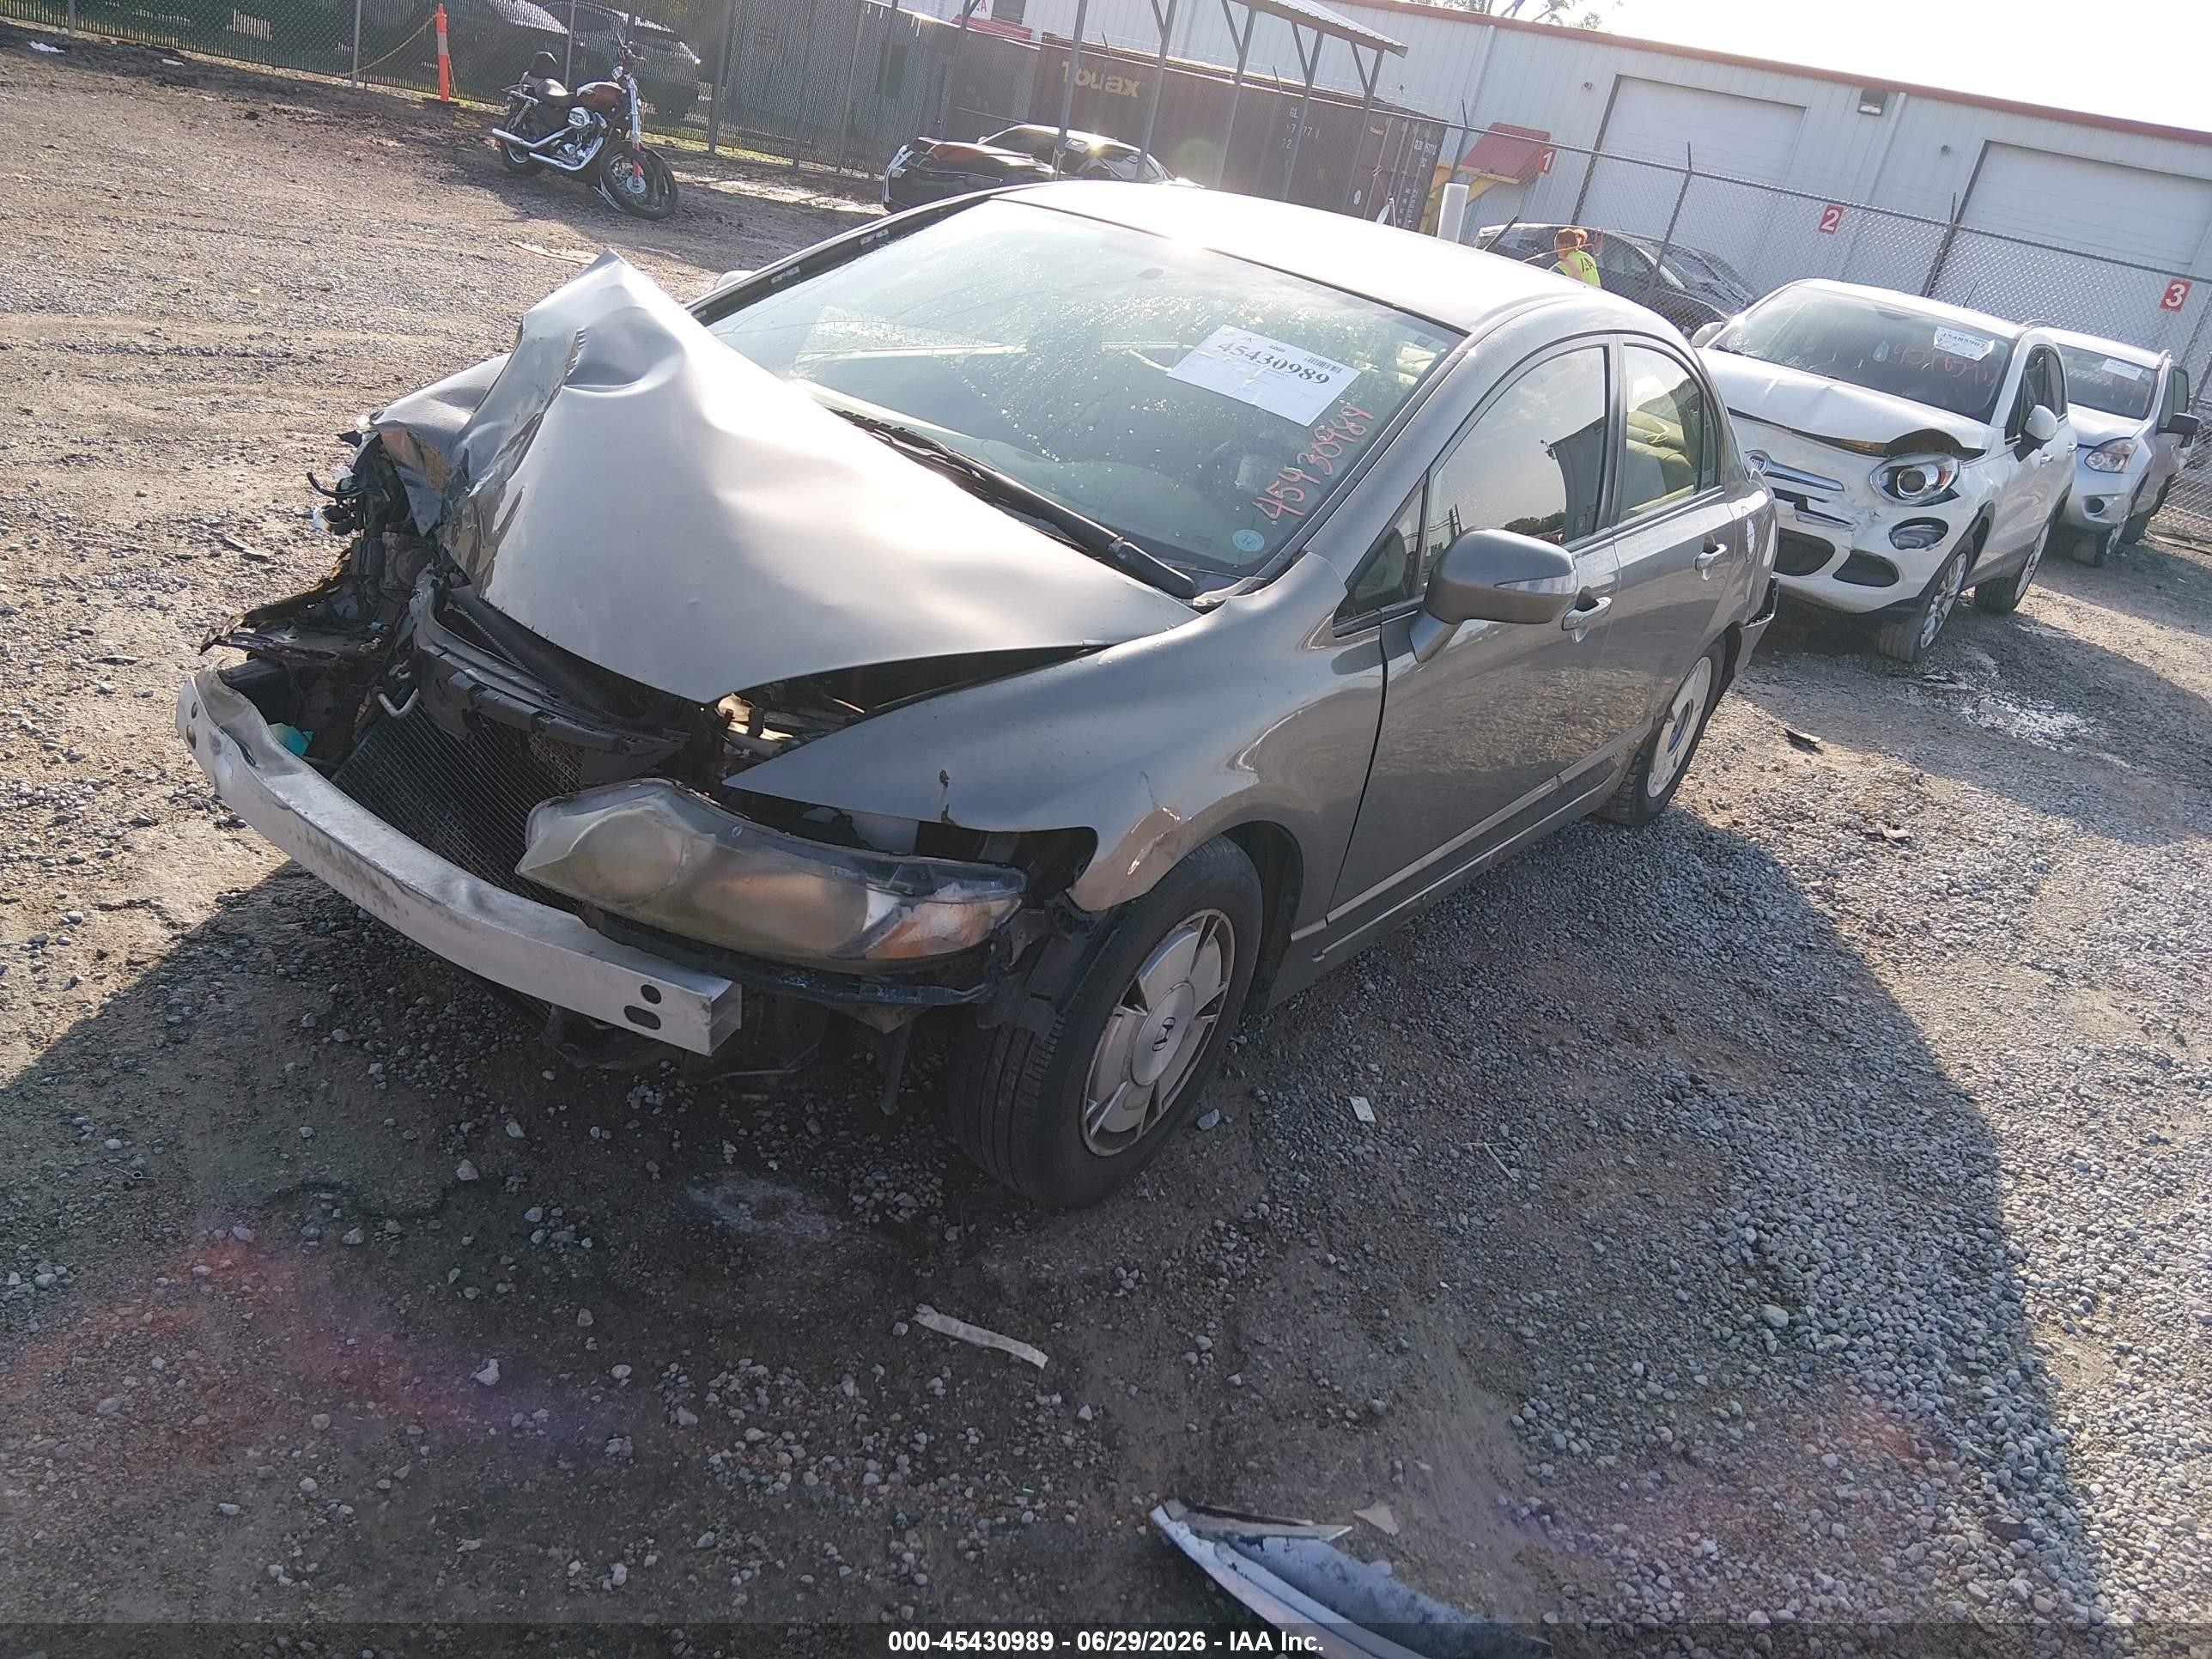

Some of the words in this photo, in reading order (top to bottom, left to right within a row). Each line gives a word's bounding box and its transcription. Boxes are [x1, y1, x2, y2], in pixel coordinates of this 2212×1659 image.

[1543, 150, 1553, 171] 1
[1820, 209, 1839, 231] 2
[2165, 283, 2185, 307] 3
[1218, 342, 1330, 385] 45430989
[1252, 404, 1375, 520] 45430989
